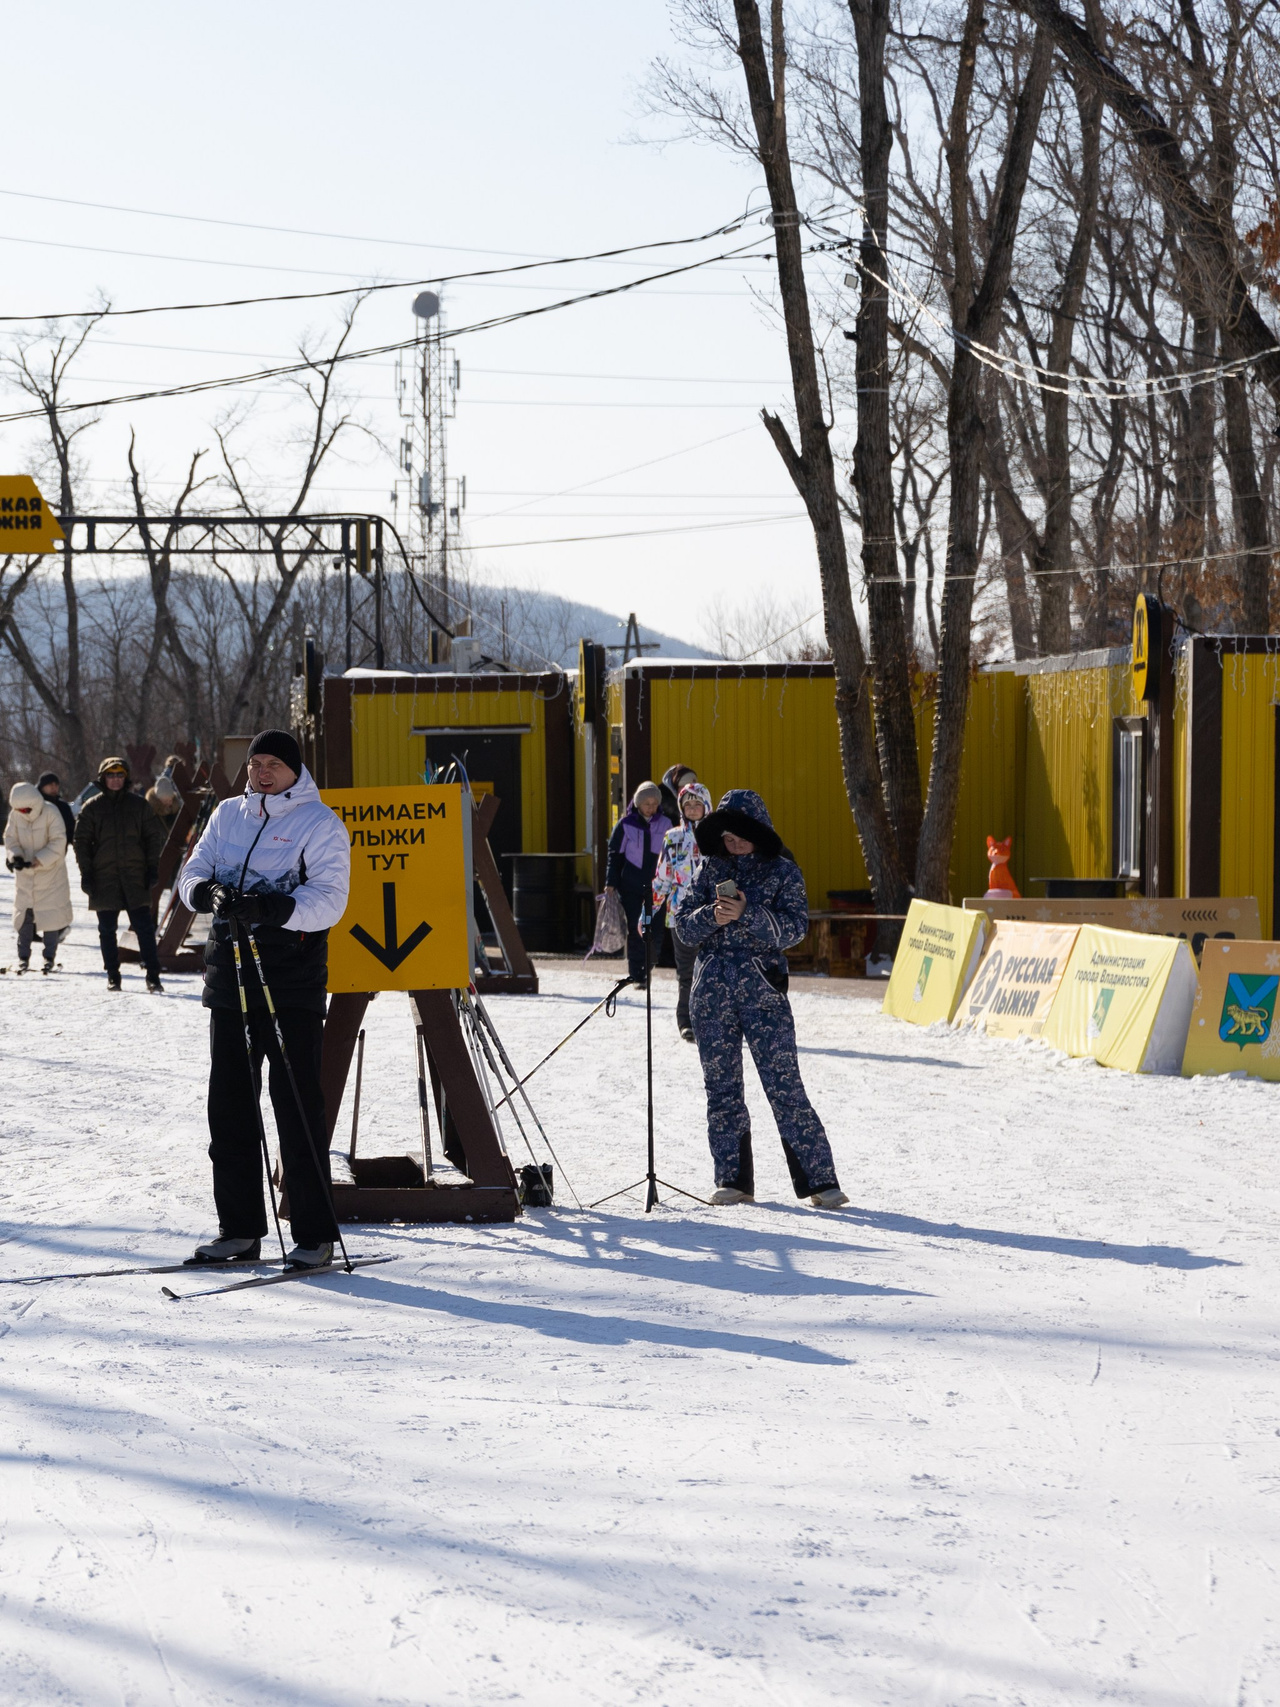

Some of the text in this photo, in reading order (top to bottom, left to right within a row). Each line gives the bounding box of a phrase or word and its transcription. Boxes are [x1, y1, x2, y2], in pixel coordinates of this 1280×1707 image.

[350, 828, 425, 847] ЛЫЖИ
[367, 853, 409, 871] ТУТ
[918, 920, 955, 943] Администрация
[908, 937, 956, 960] города Владивостока
[1001, 955, 1058, 985] РУССКАЯ
[1090, 949, 1146, 971] Администрация
[1074, 968, 1150, 989] города Владивостока
[989, 988, 1041, 1017] ЛЫЖНЯ
